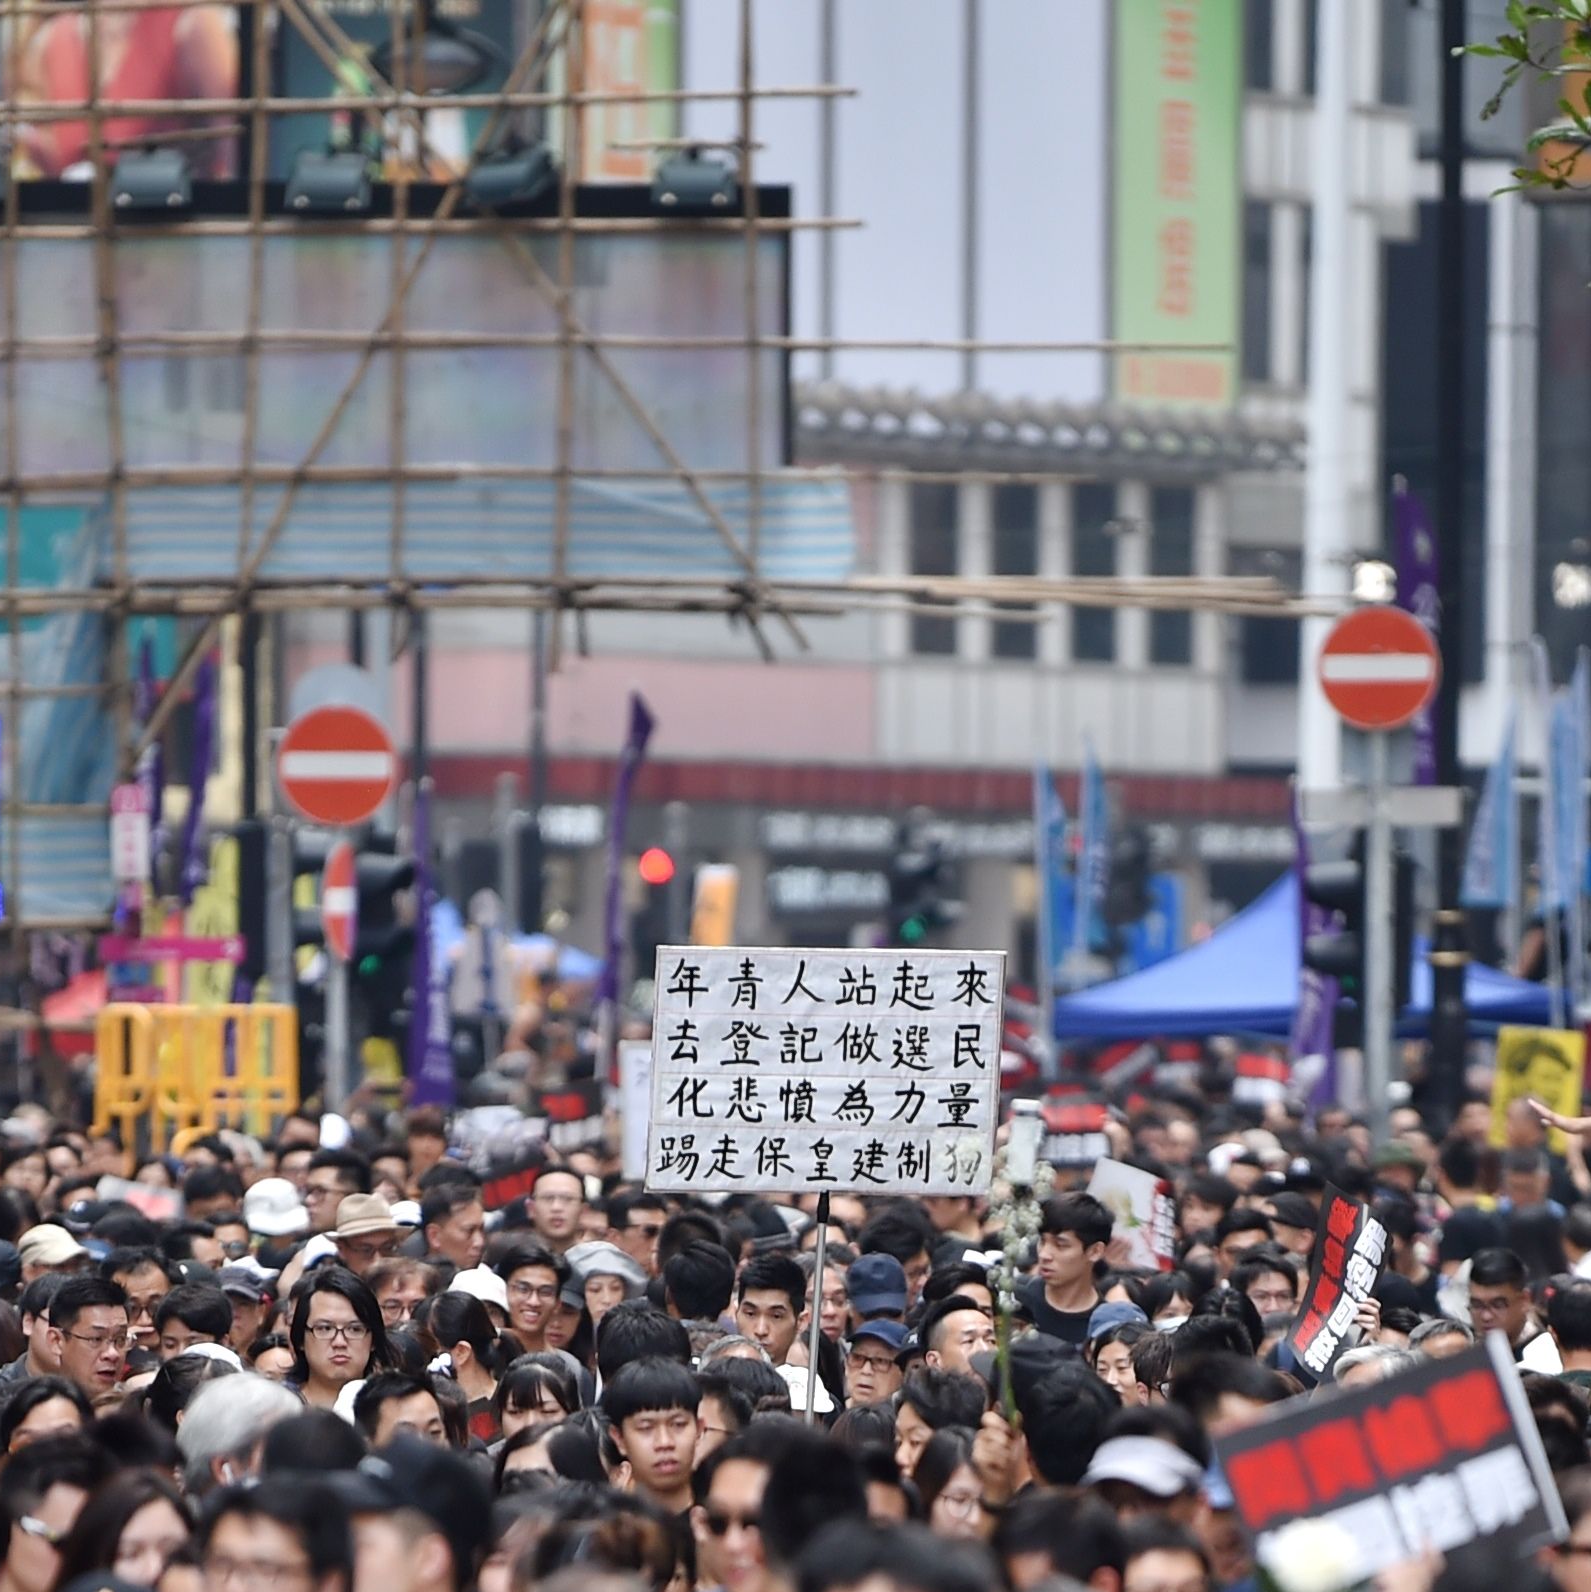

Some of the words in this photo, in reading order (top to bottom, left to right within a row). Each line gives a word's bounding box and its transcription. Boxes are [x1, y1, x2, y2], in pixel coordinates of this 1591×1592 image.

[666, 957, 995, 1011] 年青人站起來
[666, 1019, 986, 1072] 去登記做選民
[666, 1076, 979, 1130] 化悲憤為力量
[655, 1133, 983, 1186] 踢走保皇建制狗
